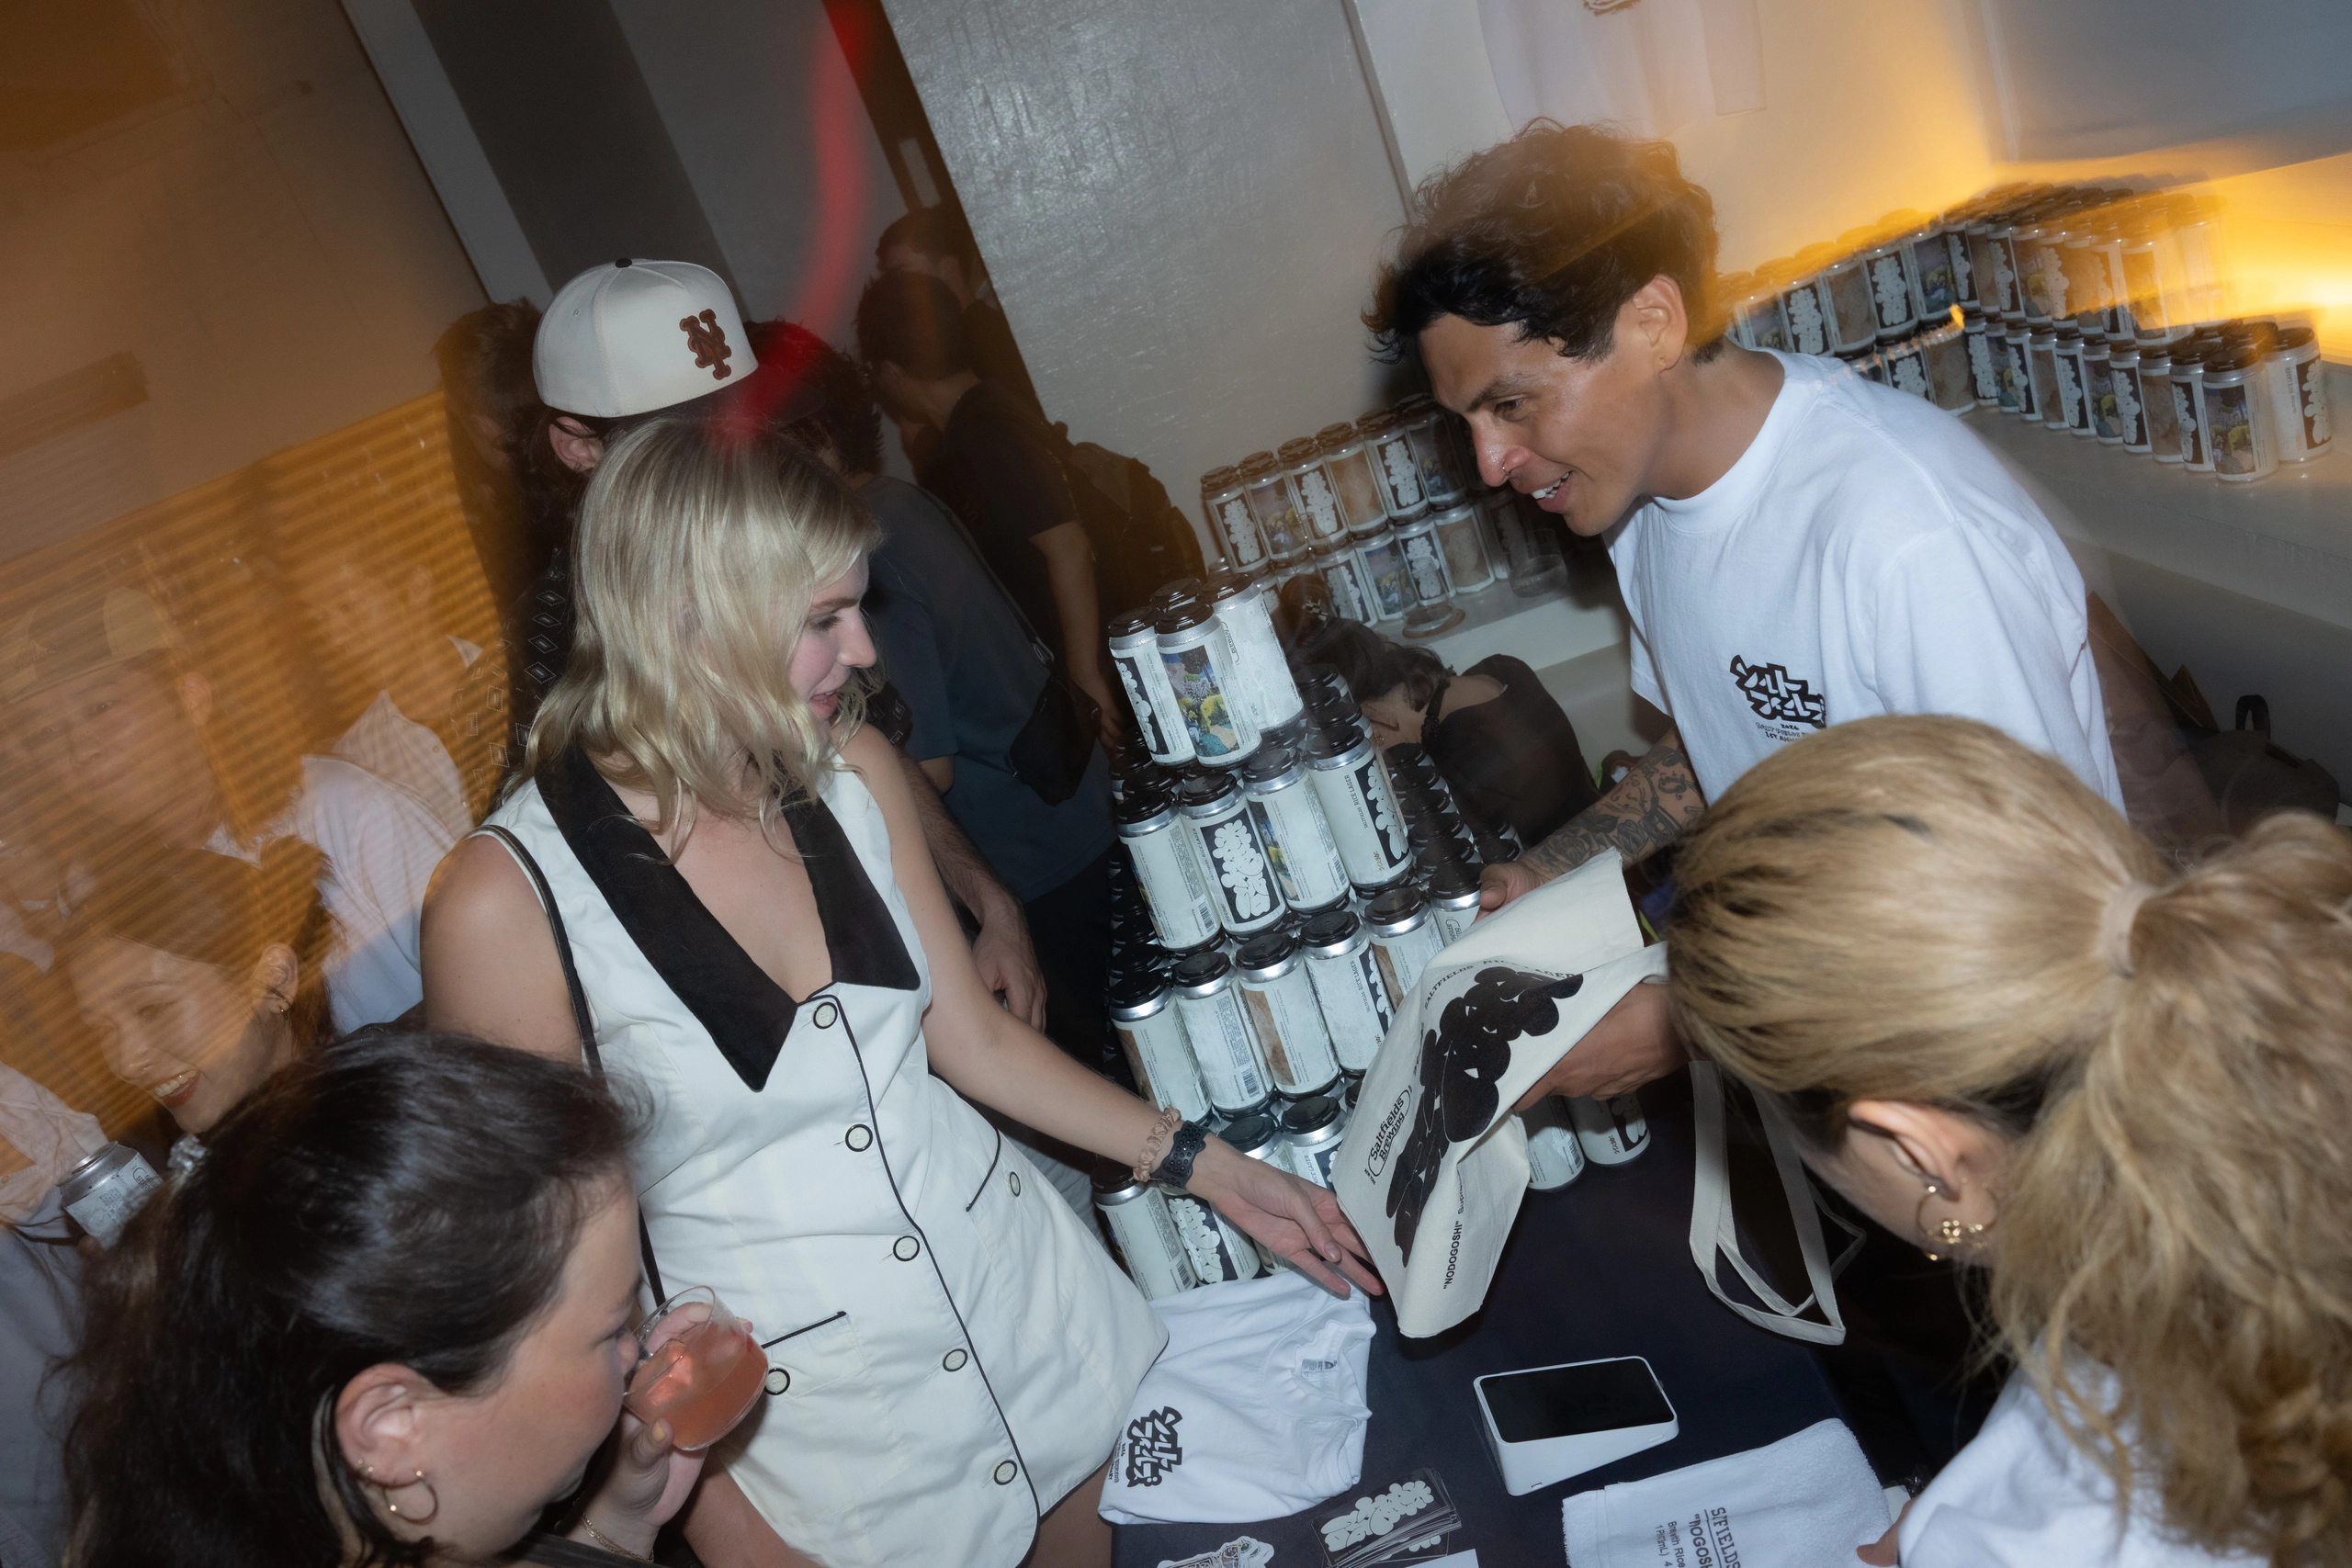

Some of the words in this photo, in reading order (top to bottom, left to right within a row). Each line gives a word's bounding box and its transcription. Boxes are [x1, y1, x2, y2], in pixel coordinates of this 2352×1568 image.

[1342, 773, 1355, 794] LAGER
[1349, 791, 1361, 807] RICE
[1191, 828, 1202, 846] LAGER
[1348, 959, 1360, 978] LAGER
[1354, 976, 1364, 991] RICE
[1424, 965, 1474, 1010] SALTFIELDS
[1369, 1097, 1405, 1161] Saltfields
[1378, 1111, 1406, 1162] Brewing
[1443, 1220, 1463, 1290] "NODOGOSHI"
[1674, 1547, 1686, 1568] Rice
